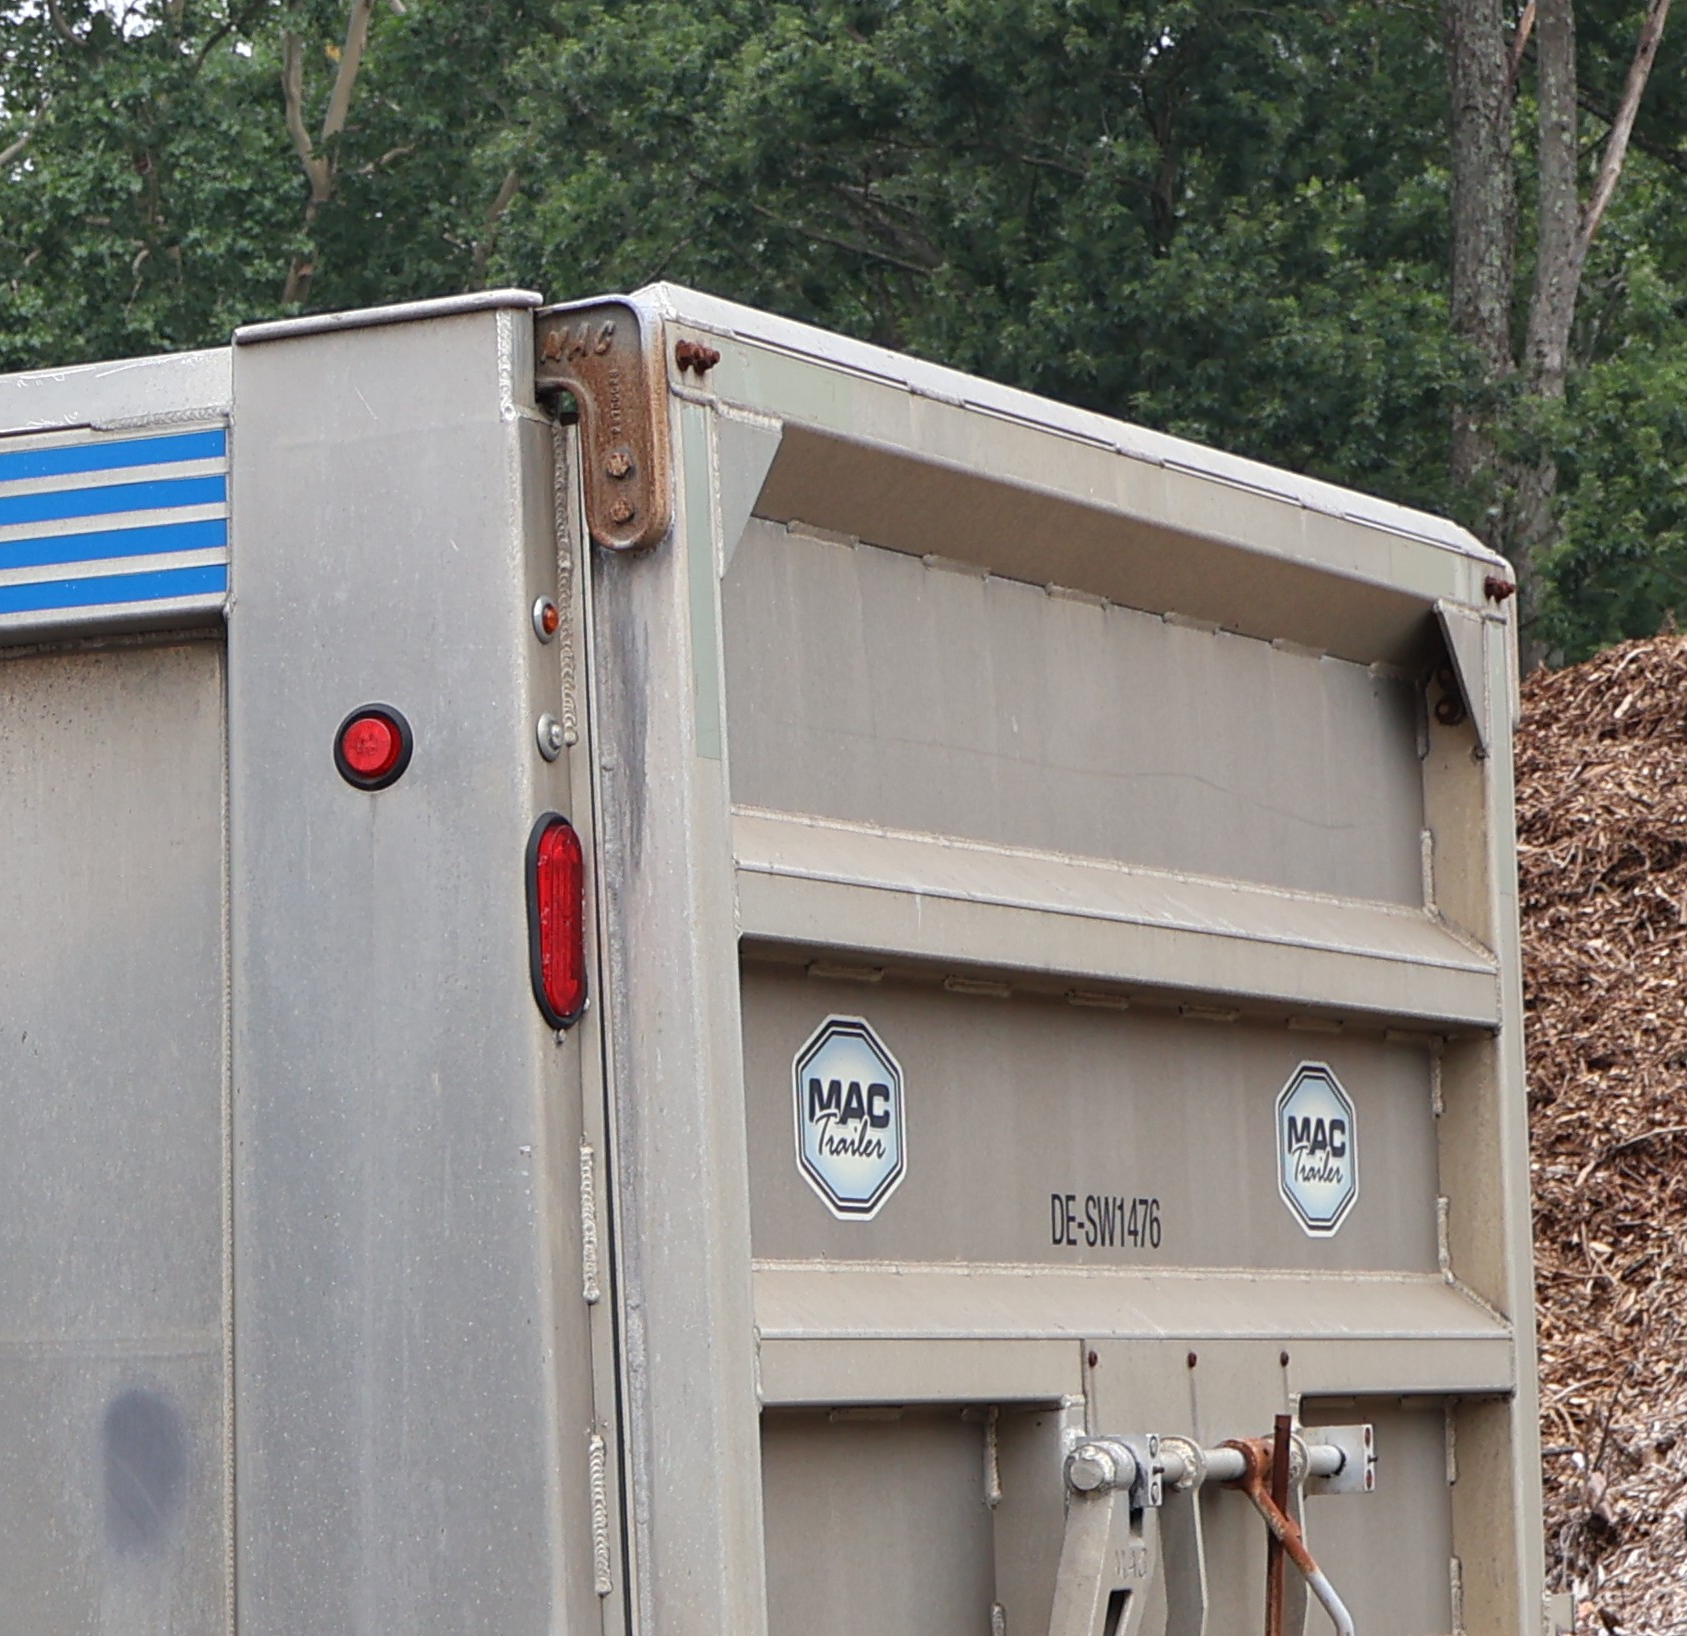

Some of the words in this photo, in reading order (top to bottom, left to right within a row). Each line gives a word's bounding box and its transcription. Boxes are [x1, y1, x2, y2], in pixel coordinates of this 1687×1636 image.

[809, 1078, 891, 1130] MAC
[815, 1111, 887, 1160] Trailer
[1287, 1116, 1347, 1158] MAC
[1292, 1144, 1344, 1185] Trailer
[1051, 1193, 1162, 1249] DE-SW1476
